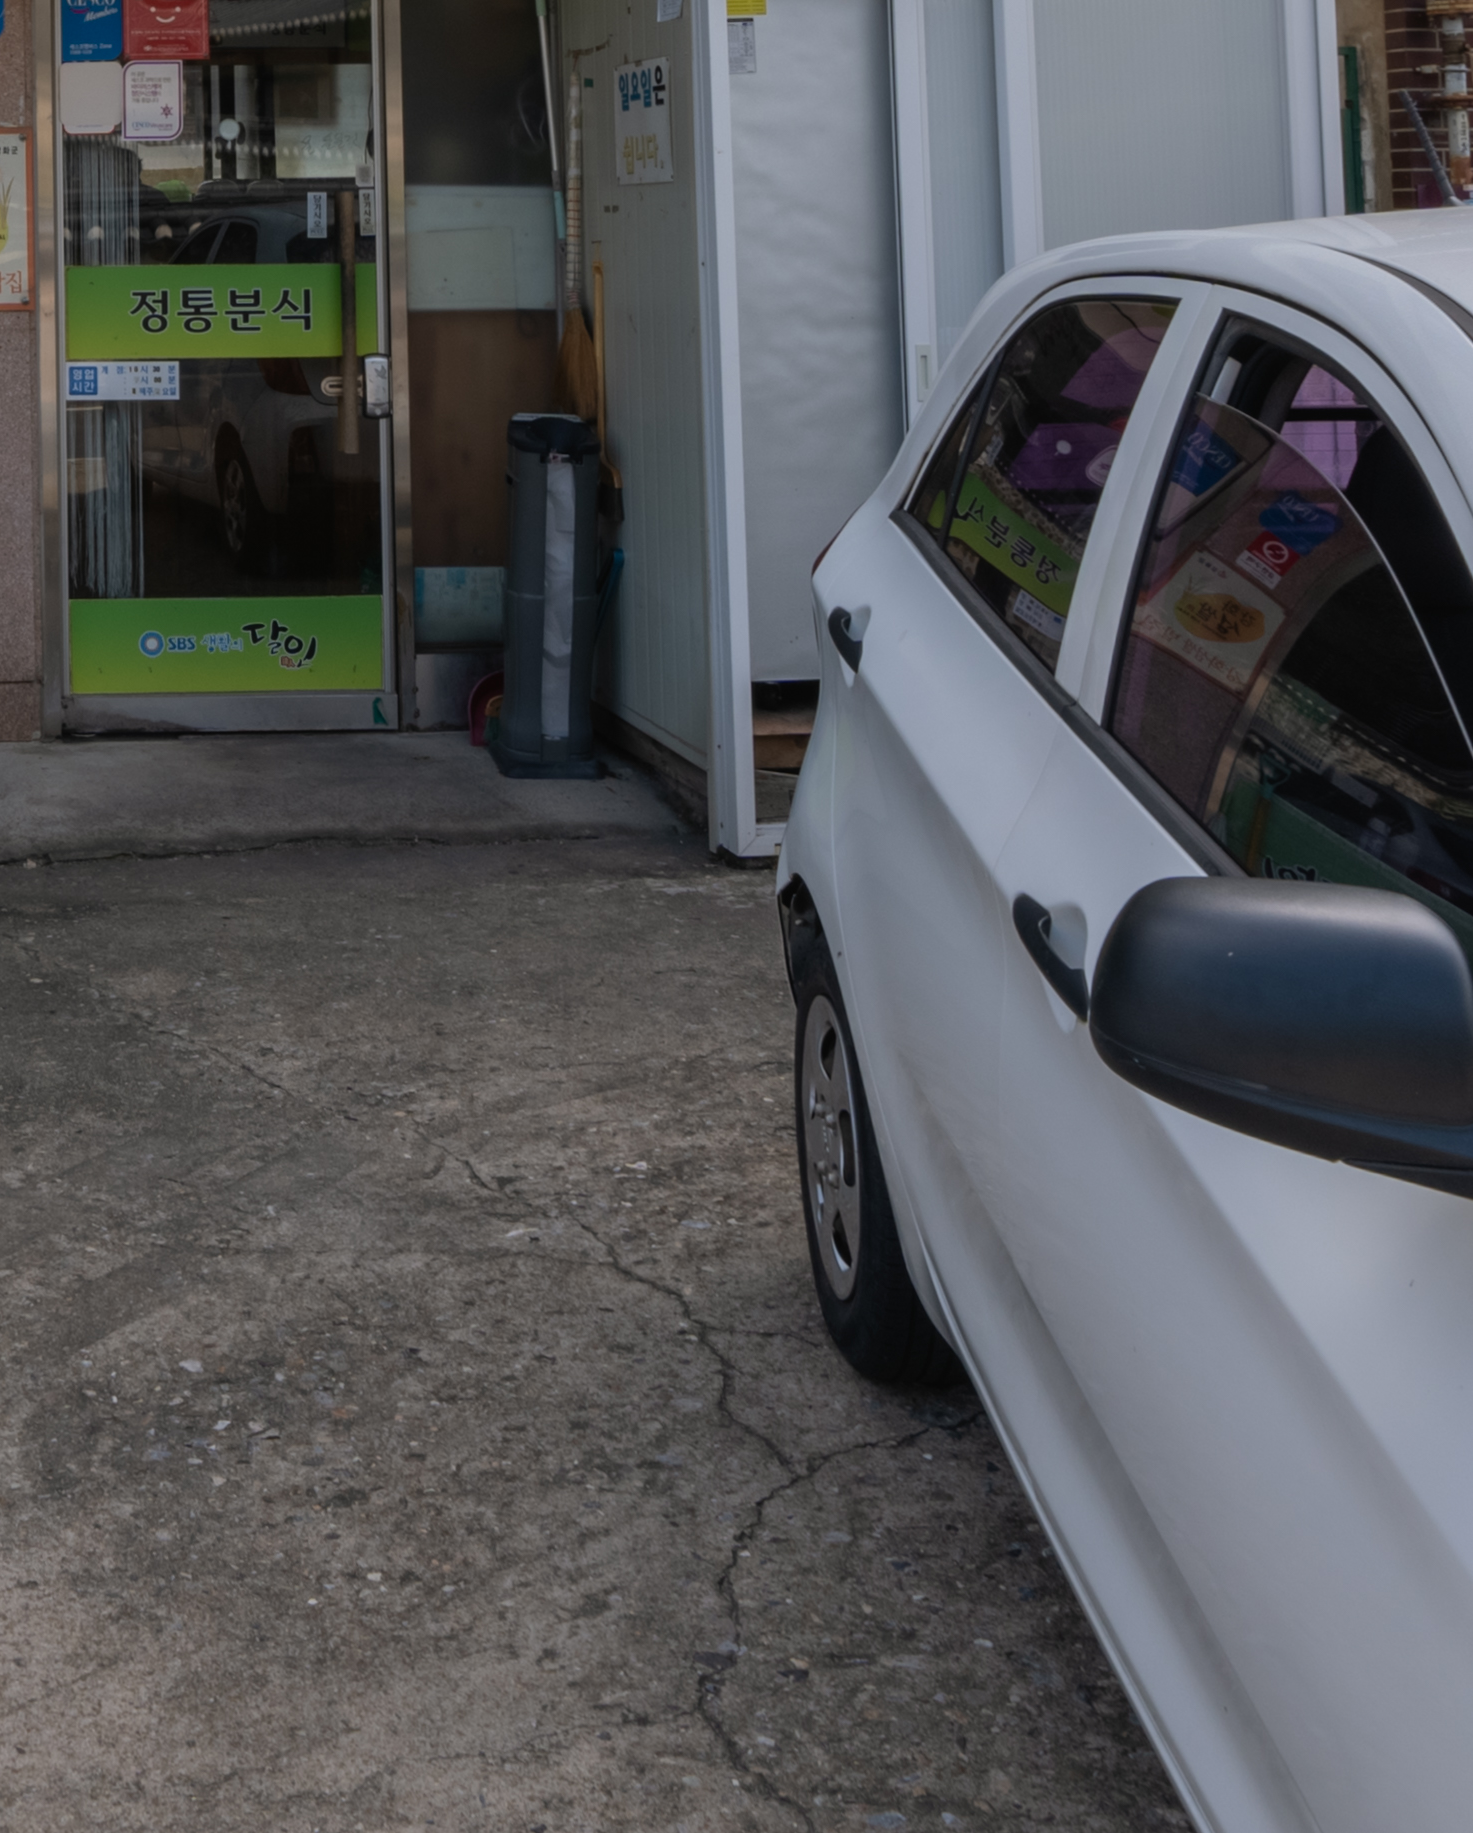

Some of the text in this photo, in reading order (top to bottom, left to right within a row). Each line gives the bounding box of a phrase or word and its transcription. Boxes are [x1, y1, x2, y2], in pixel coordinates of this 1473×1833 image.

[618, 64, 667, 112] 일요일은
[312, 194, 323, 228] 당기시오
[129, 288, 313, 333] 정통분식
[71, 381, 95, 393] 시간
[72, 369, 95, 381] 영업
[167, 635, 197, 653] SBS
